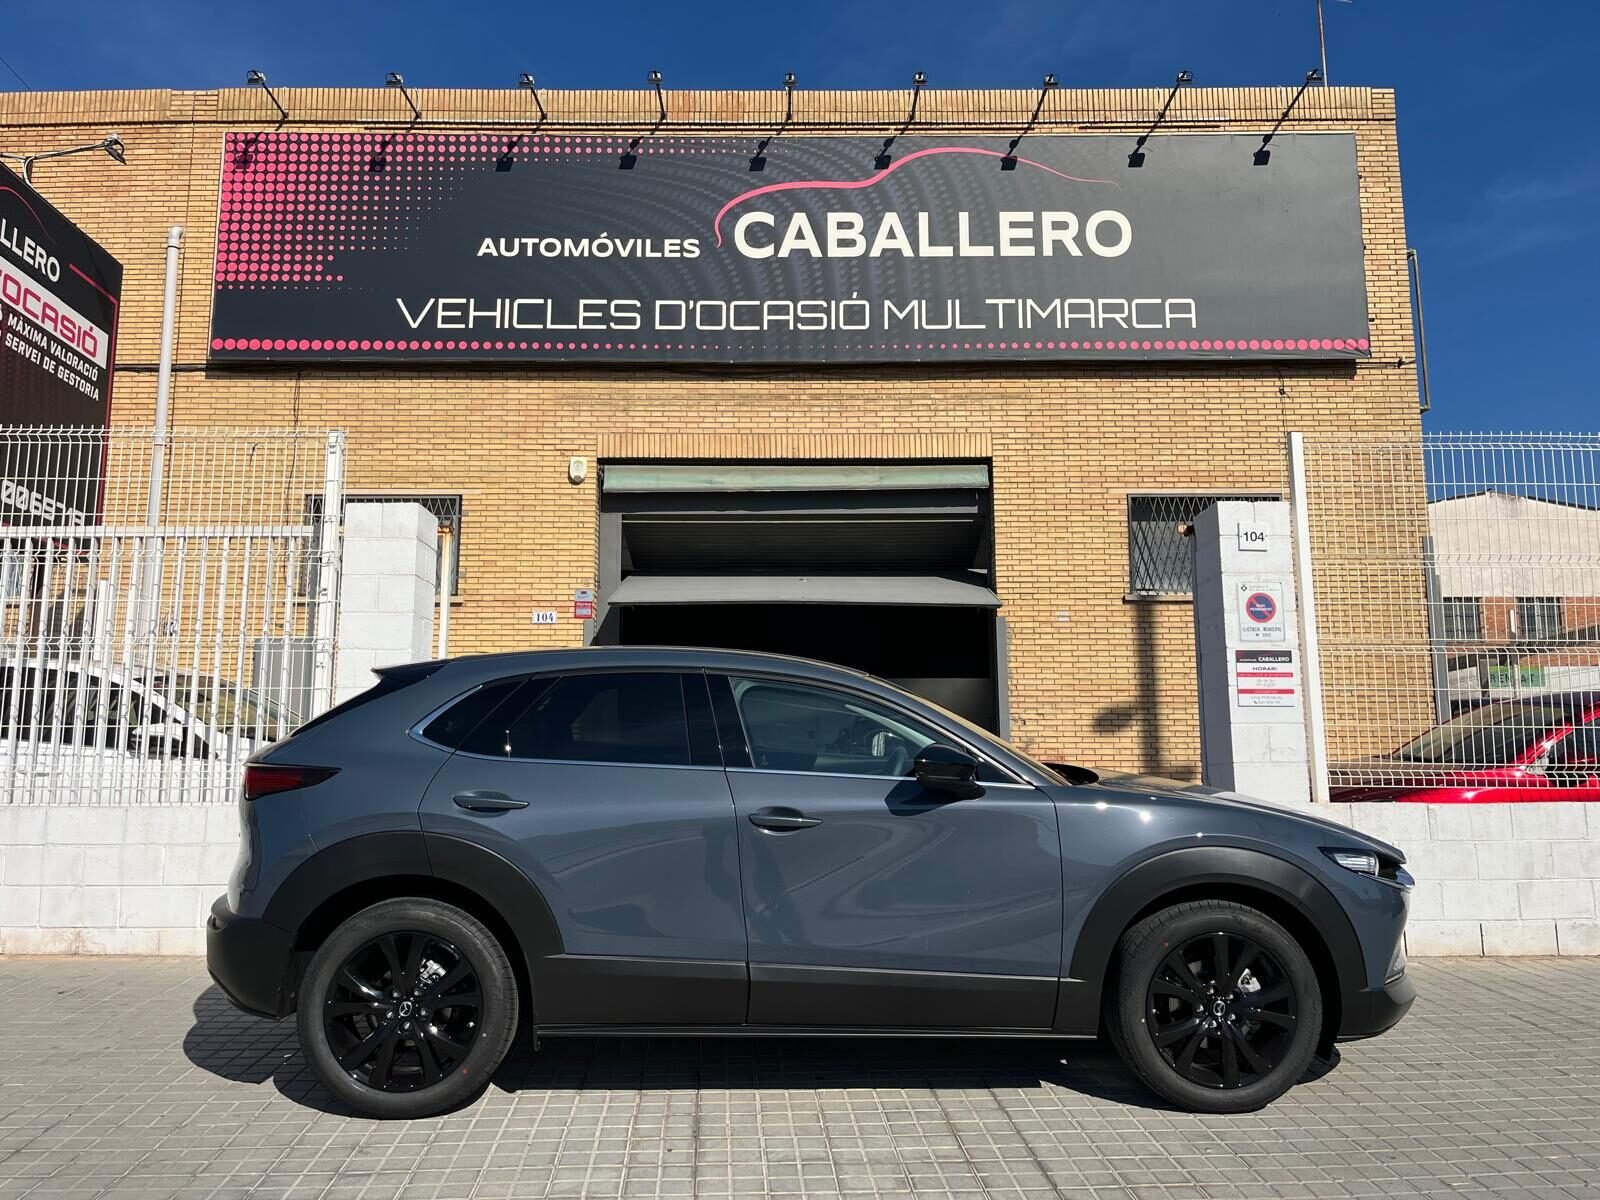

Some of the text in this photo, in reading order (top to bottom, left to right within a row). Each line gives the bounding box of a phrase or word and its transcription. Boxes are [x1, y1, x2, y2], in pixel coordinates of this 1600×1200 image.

[477, 210, 1133, 258] AUTOMÓVILES CABALLERO
[396, 292, 1197, 331] VEHICLES D'OCASIÓ MULTIMARCA
[5, 332, 99, 401] SERVEI DE GESTORIA
[7, 313, 99, 382] MÀXIMA VALORACIÓ
[1243, 531, 1265, 542] 104
[535, 612, 554, 622] 104
